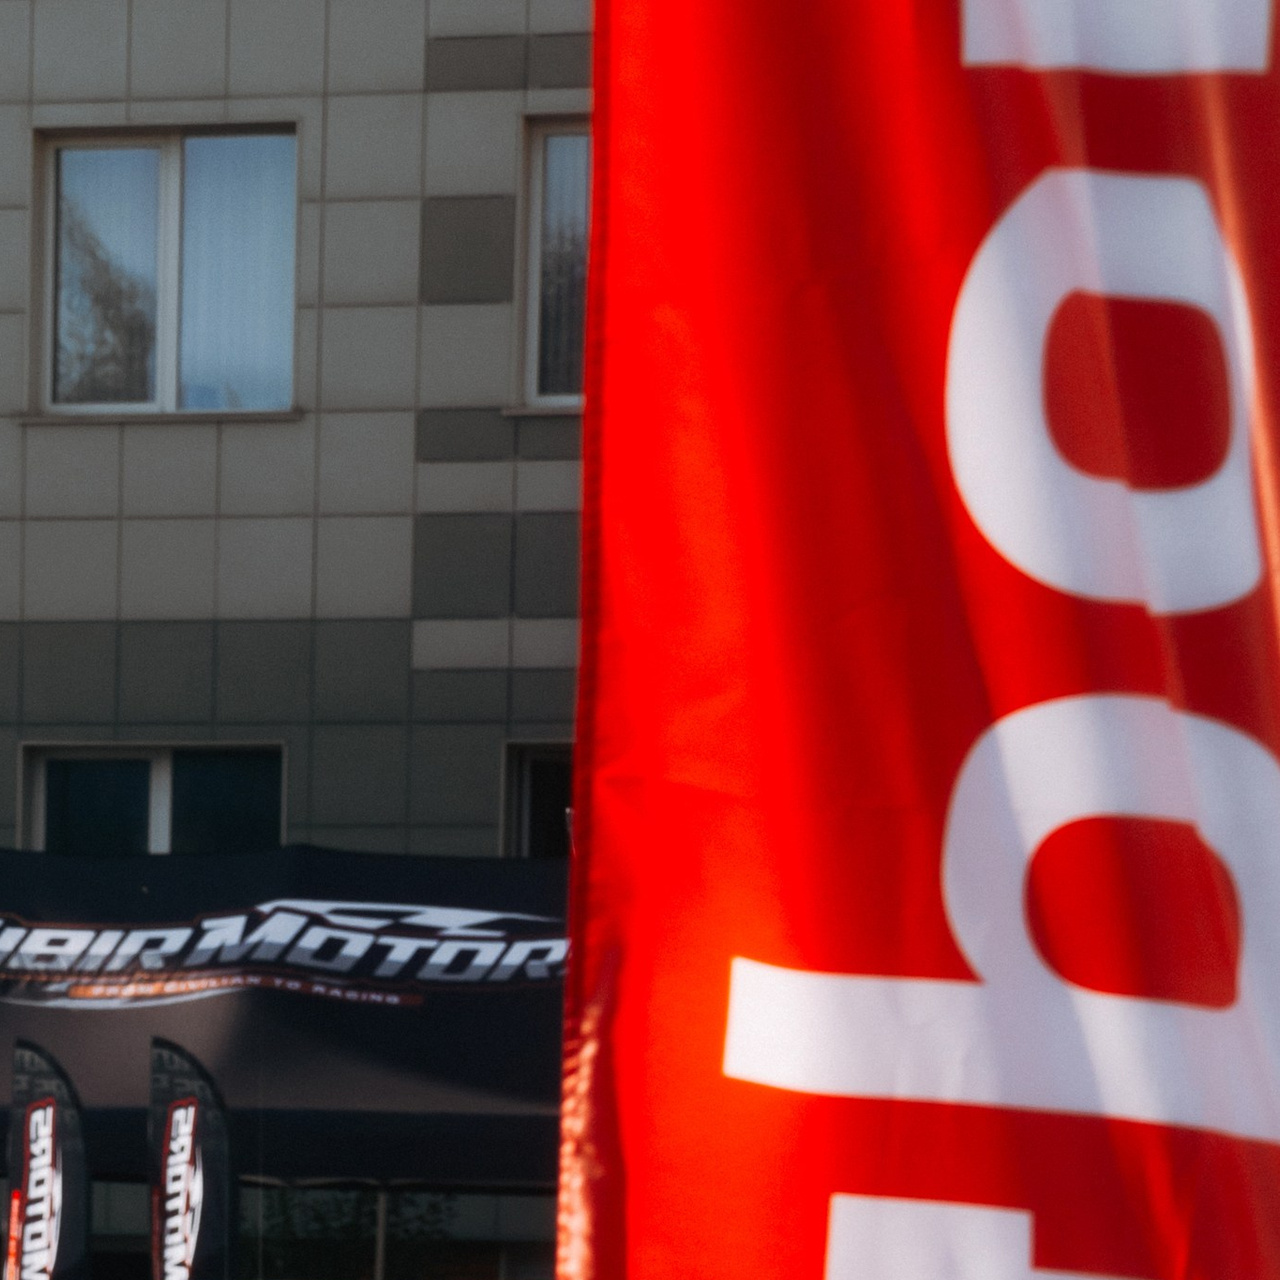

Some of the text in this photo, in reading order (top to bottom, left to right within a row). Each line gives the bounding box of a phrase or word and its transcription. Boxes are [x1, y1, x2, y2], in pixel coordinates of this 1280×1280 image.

[183, 911, 572, 982] MOTOR
[272, 976, 302, 990] TO
[311, 983, 401, 1004] RACING
